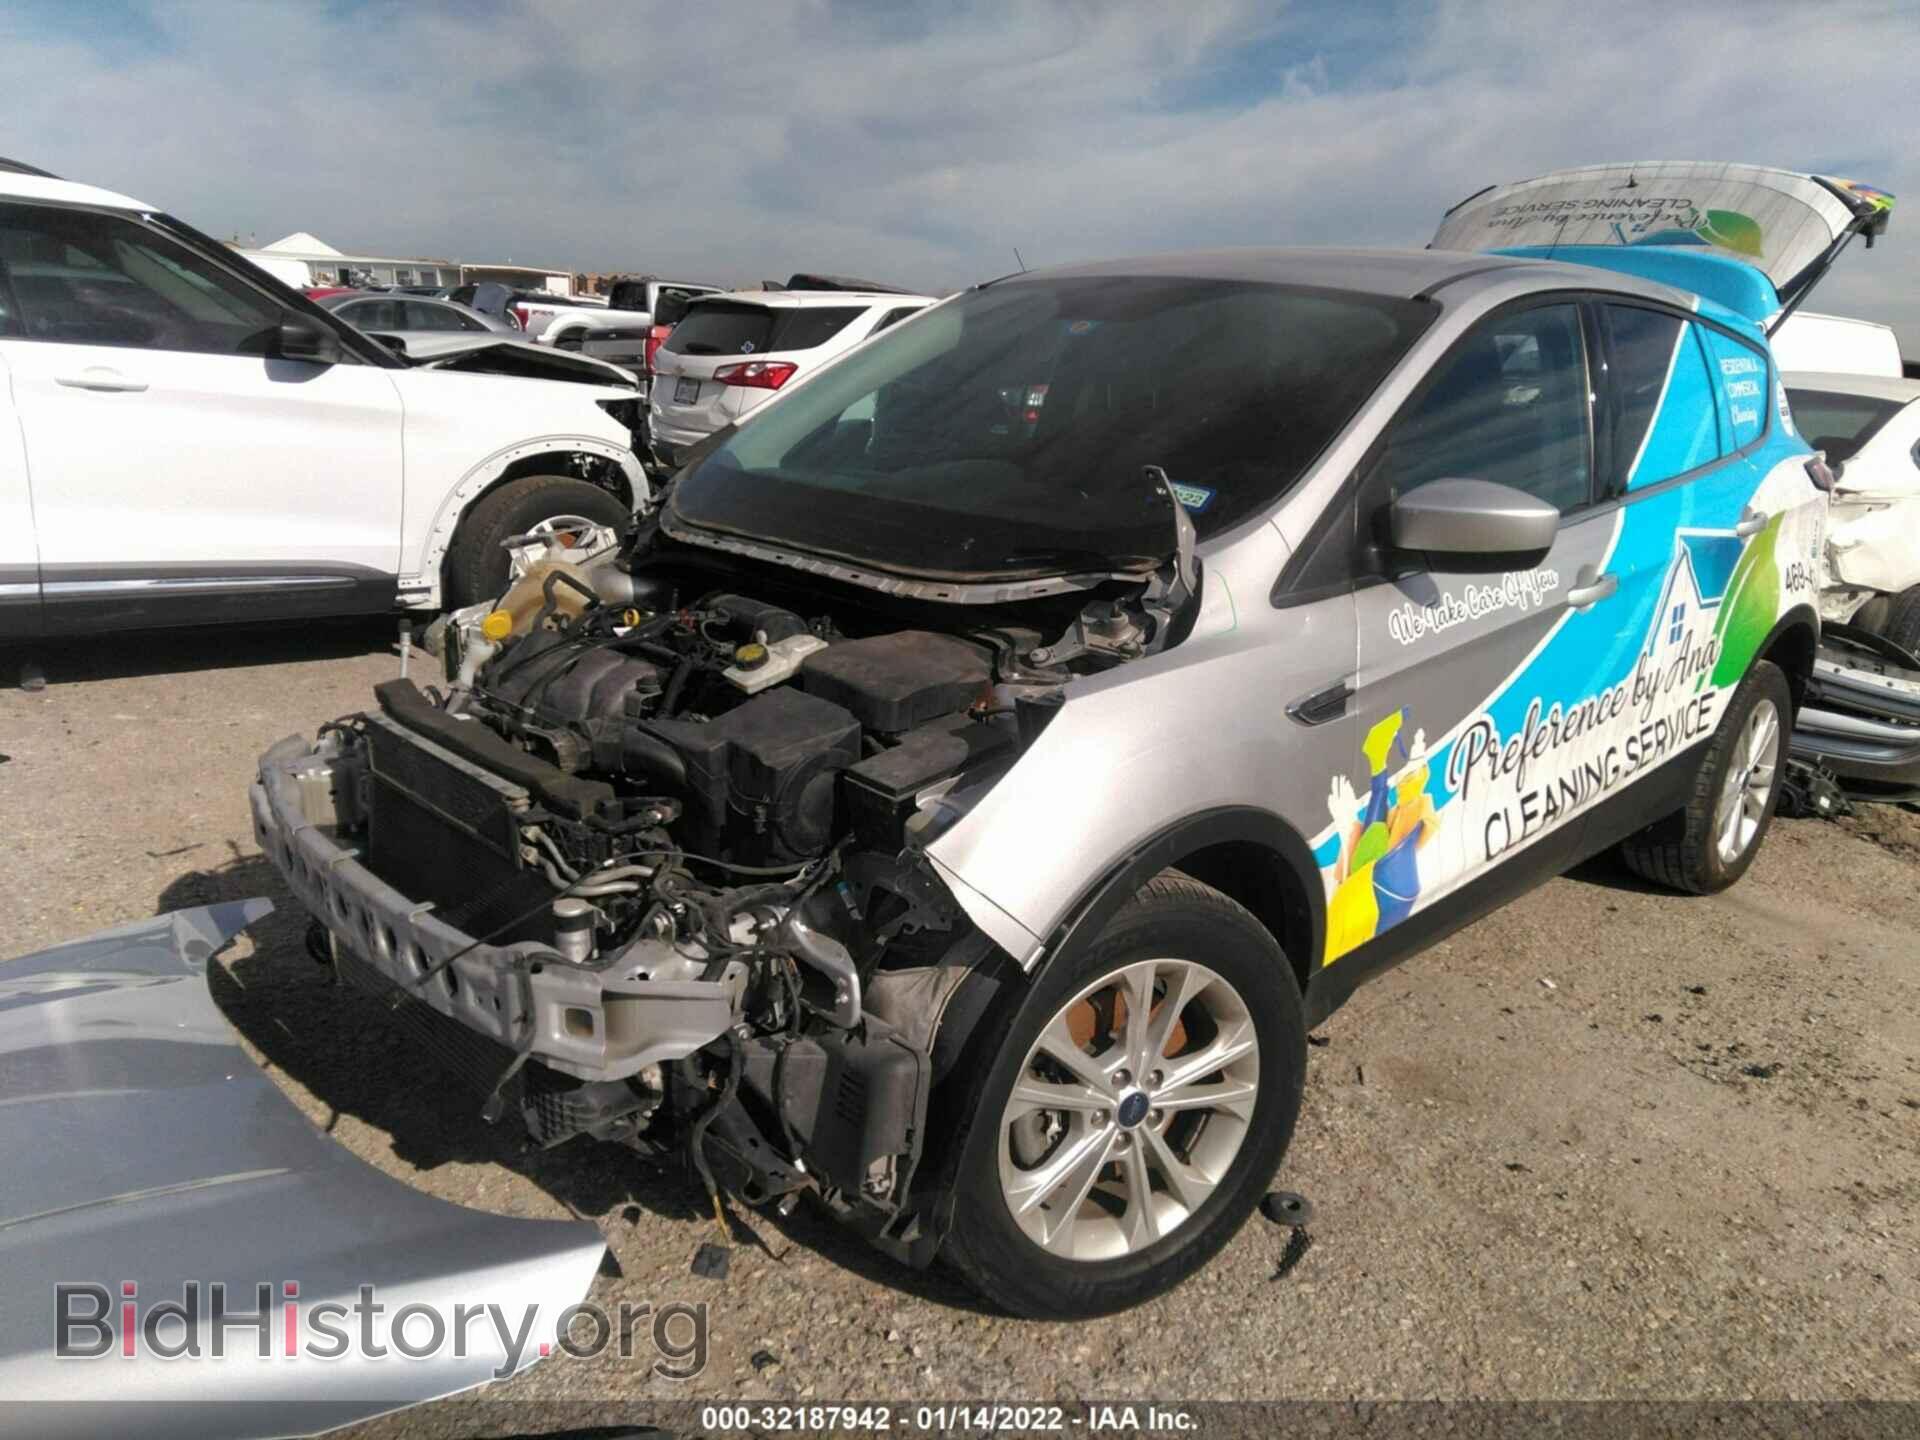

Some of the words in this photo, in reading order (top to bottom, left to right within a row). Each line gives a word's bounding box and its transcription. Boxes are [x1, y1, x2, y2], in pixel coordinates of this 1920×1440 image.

[1582, 198, 1692, 209] CLEANING
[1389, 603, 1424, 645] We
[1423, 592, 1467, 633] Take
[1464, 584, 1505, 619] Care
[1502, 571, 1528, 610] Of
[1527, 569, 1559, 606] You
[1449, 686, 1628, 801] Preference
[1632, 650, 1664, 723] by
[1664, 629, 1719, 694] Ana
[1484, 746, 1621, 862] CLEANING
[1624, 691, 1716, 778] SERVICE
